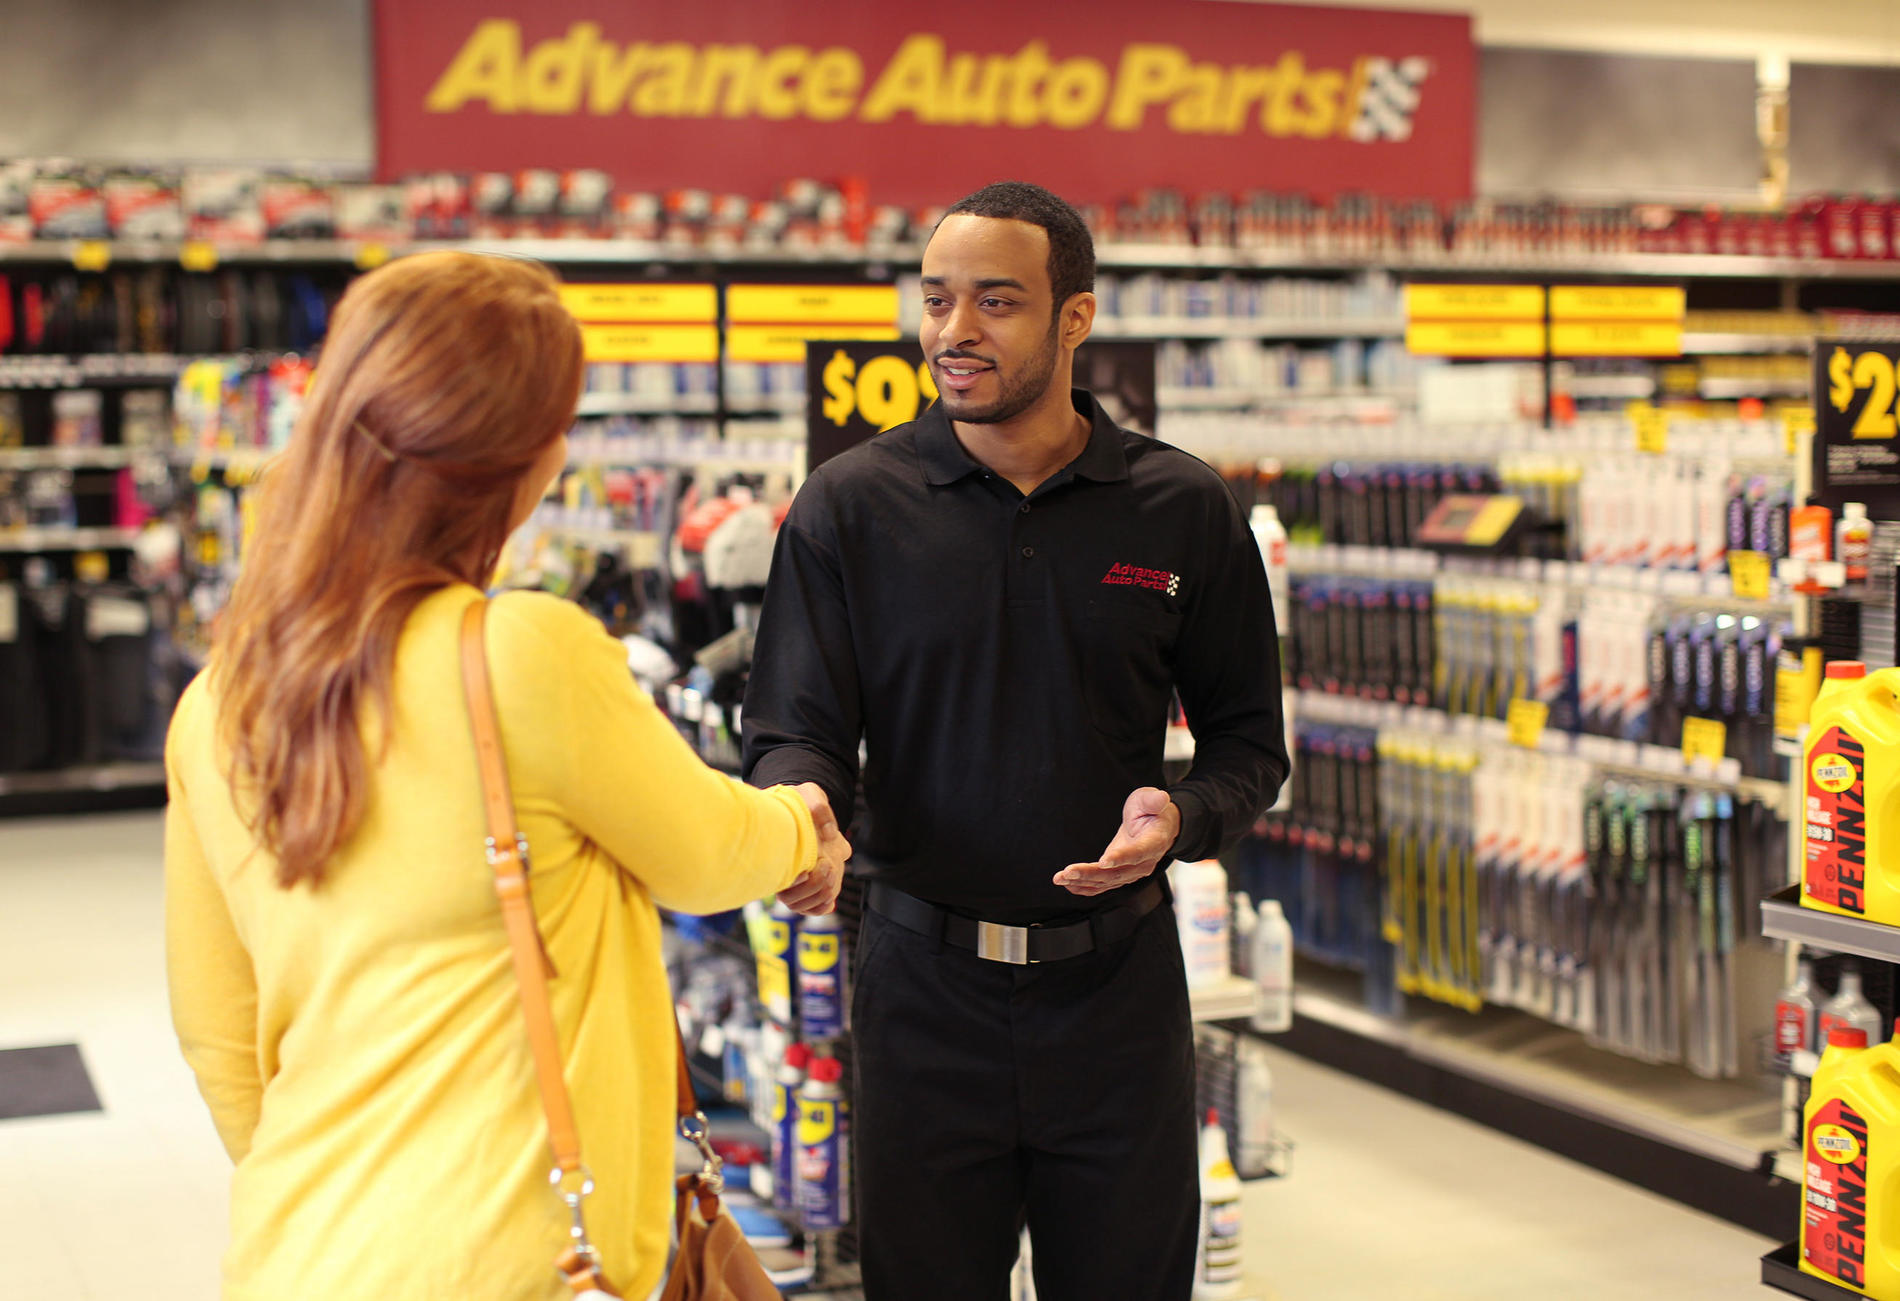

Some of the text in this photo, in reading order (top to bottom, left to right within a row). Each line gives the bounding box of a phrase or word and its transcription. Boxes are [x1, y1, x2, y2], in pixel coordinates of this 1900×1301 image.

[425, 18, 864, 121] Advance
[857, 33, 1110, 128] Auto
[1828, 346, 1900, 440] $2
[1101, 573, 1133, 585] Auto
[1108, 562, 1168, 581] Advance
[1837, 726, 1865, 915] PENNZI
[1837, 1099, 1867, 1290] PENNZI
